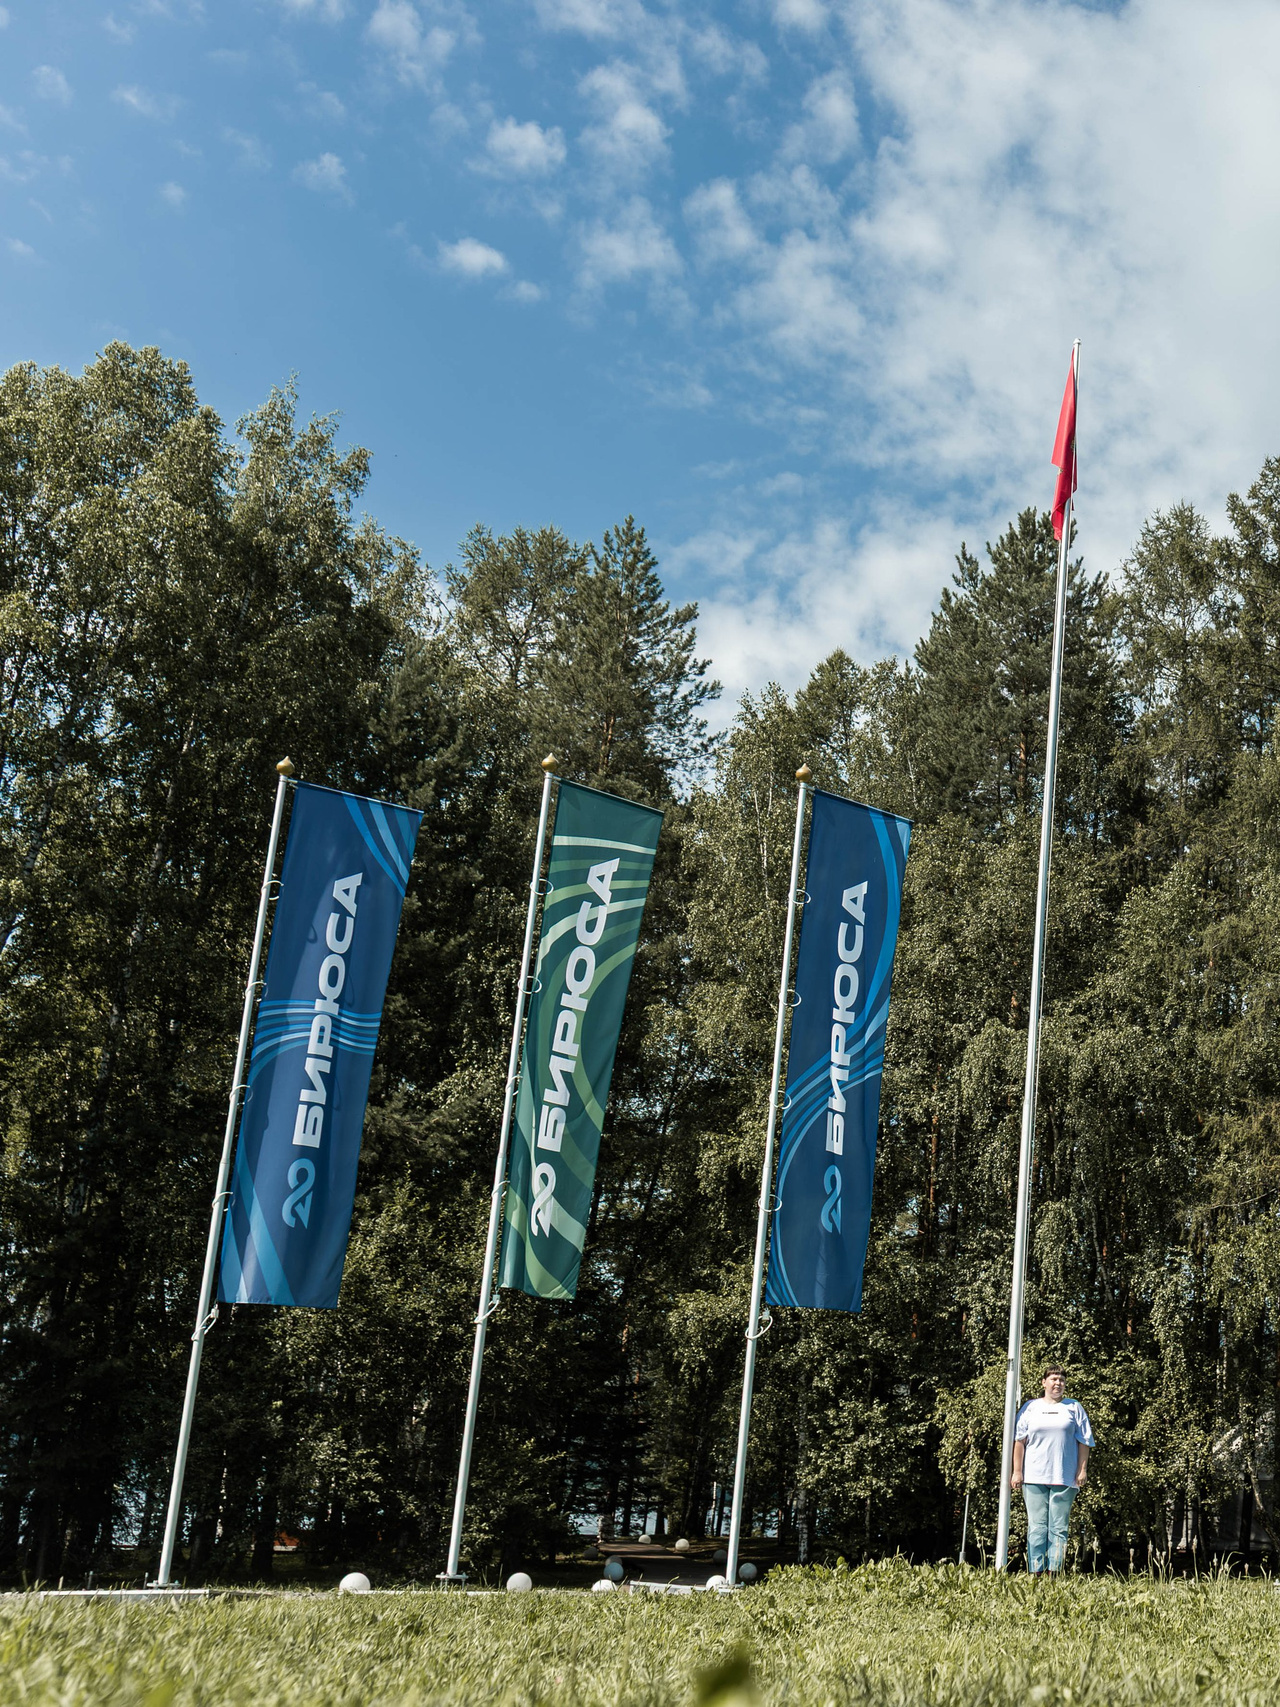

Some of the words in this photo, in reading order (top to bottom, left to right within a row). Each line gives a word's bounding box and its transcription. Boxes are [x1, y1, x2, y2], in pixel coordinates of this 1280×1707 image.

[292, 872, 362, 1148] БИРЮСА
[538, 857, 620, 1153] БИРЮСА
[825, 880, 869, 1156] БИРЮСА
